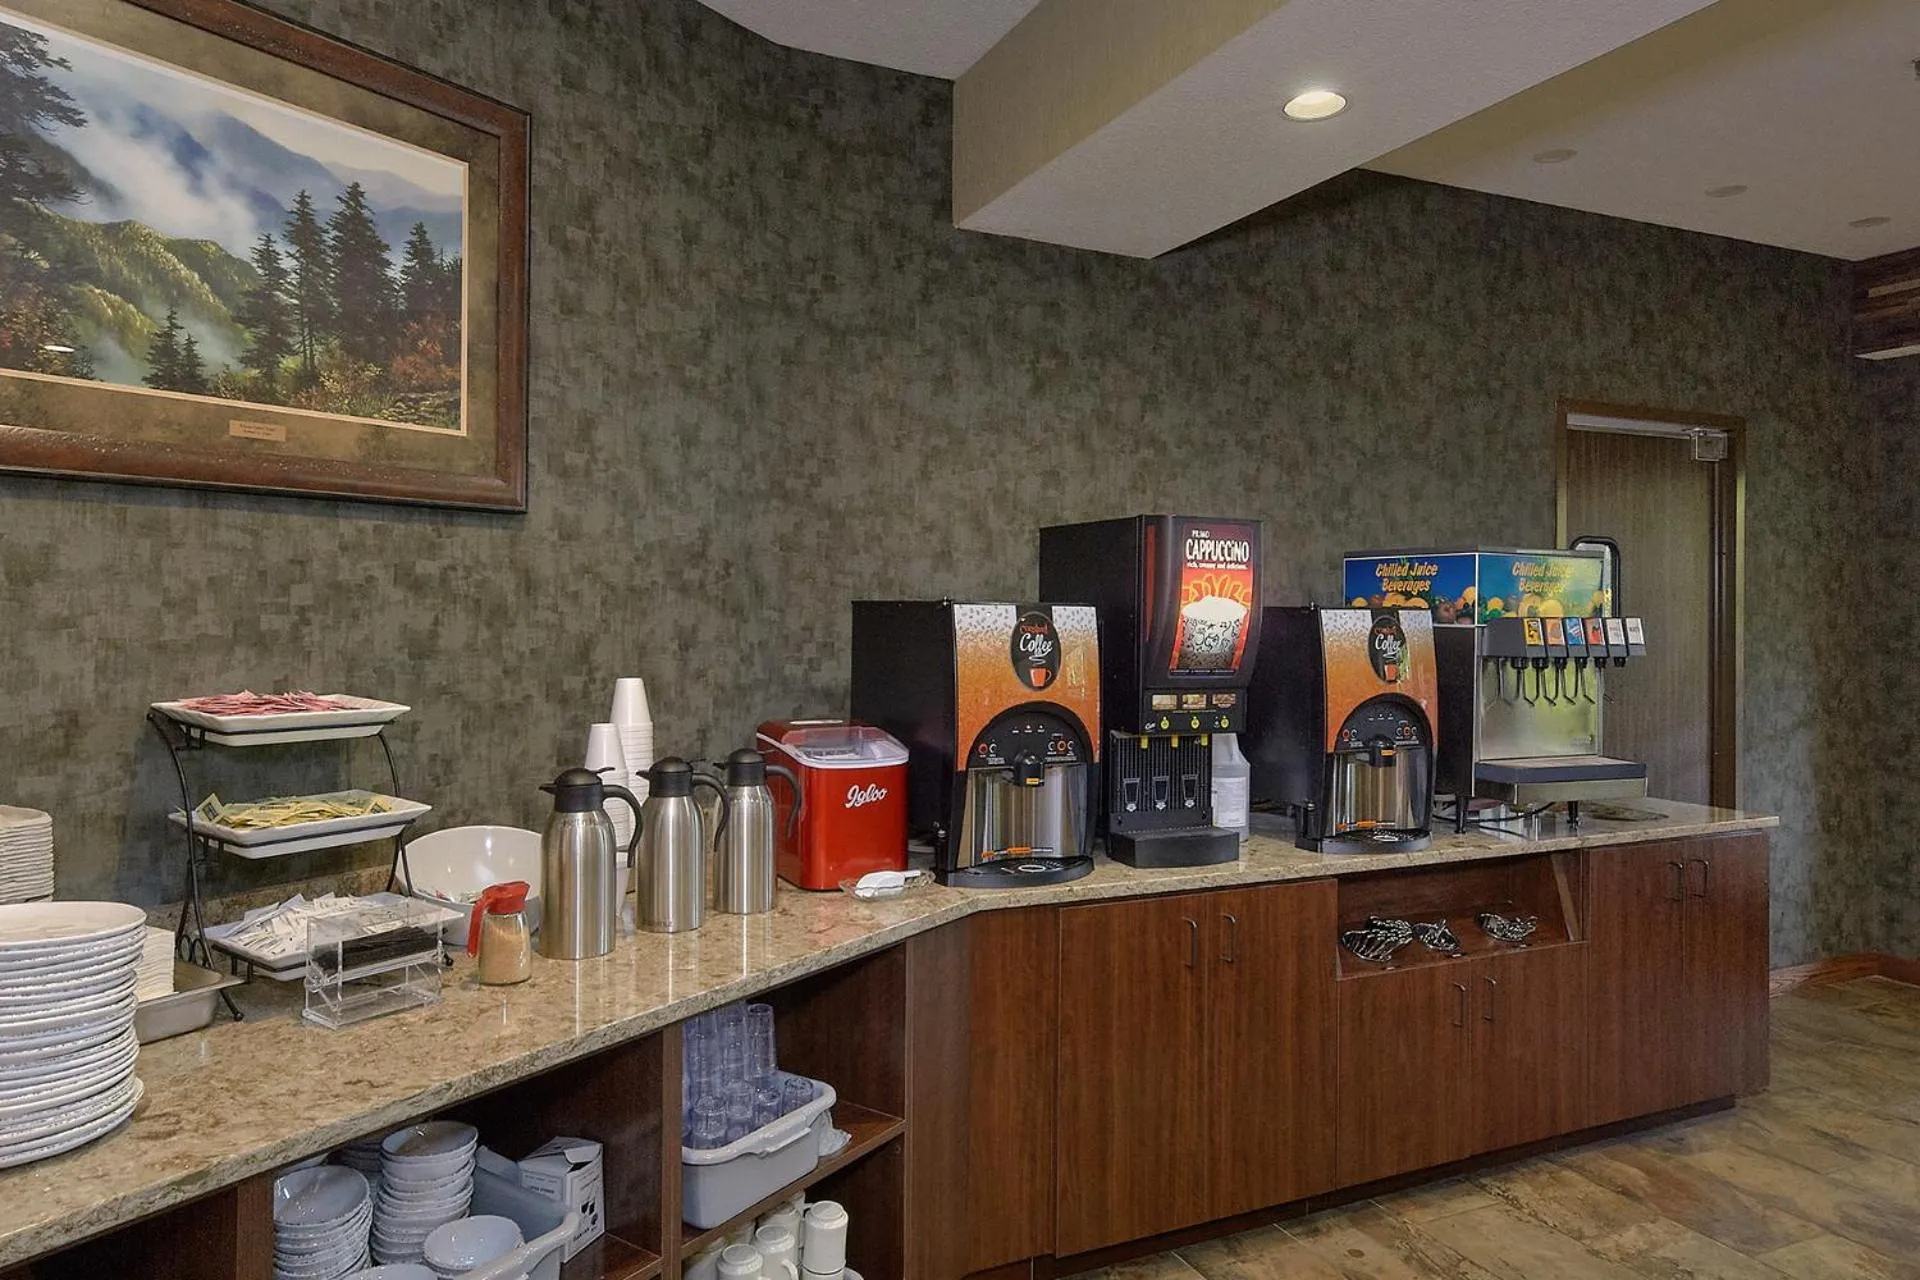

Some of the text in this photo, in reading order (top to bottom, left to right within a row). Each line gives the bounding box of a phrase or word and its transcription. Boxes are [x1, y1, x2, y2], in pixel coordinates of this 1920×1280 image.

[1375, 562, 1438, 577] Chilled Juice
[1512, 561, 1546, 577] Chilled
[1382, 578, 1431, 595] Beverages
[1519, 577, 1565, 597] Beverages
[1020, 633, 1053, 656] Coffee
[1375, 633, 1401, 655] Coffee
[845, 783, 888, 808] Igloo
